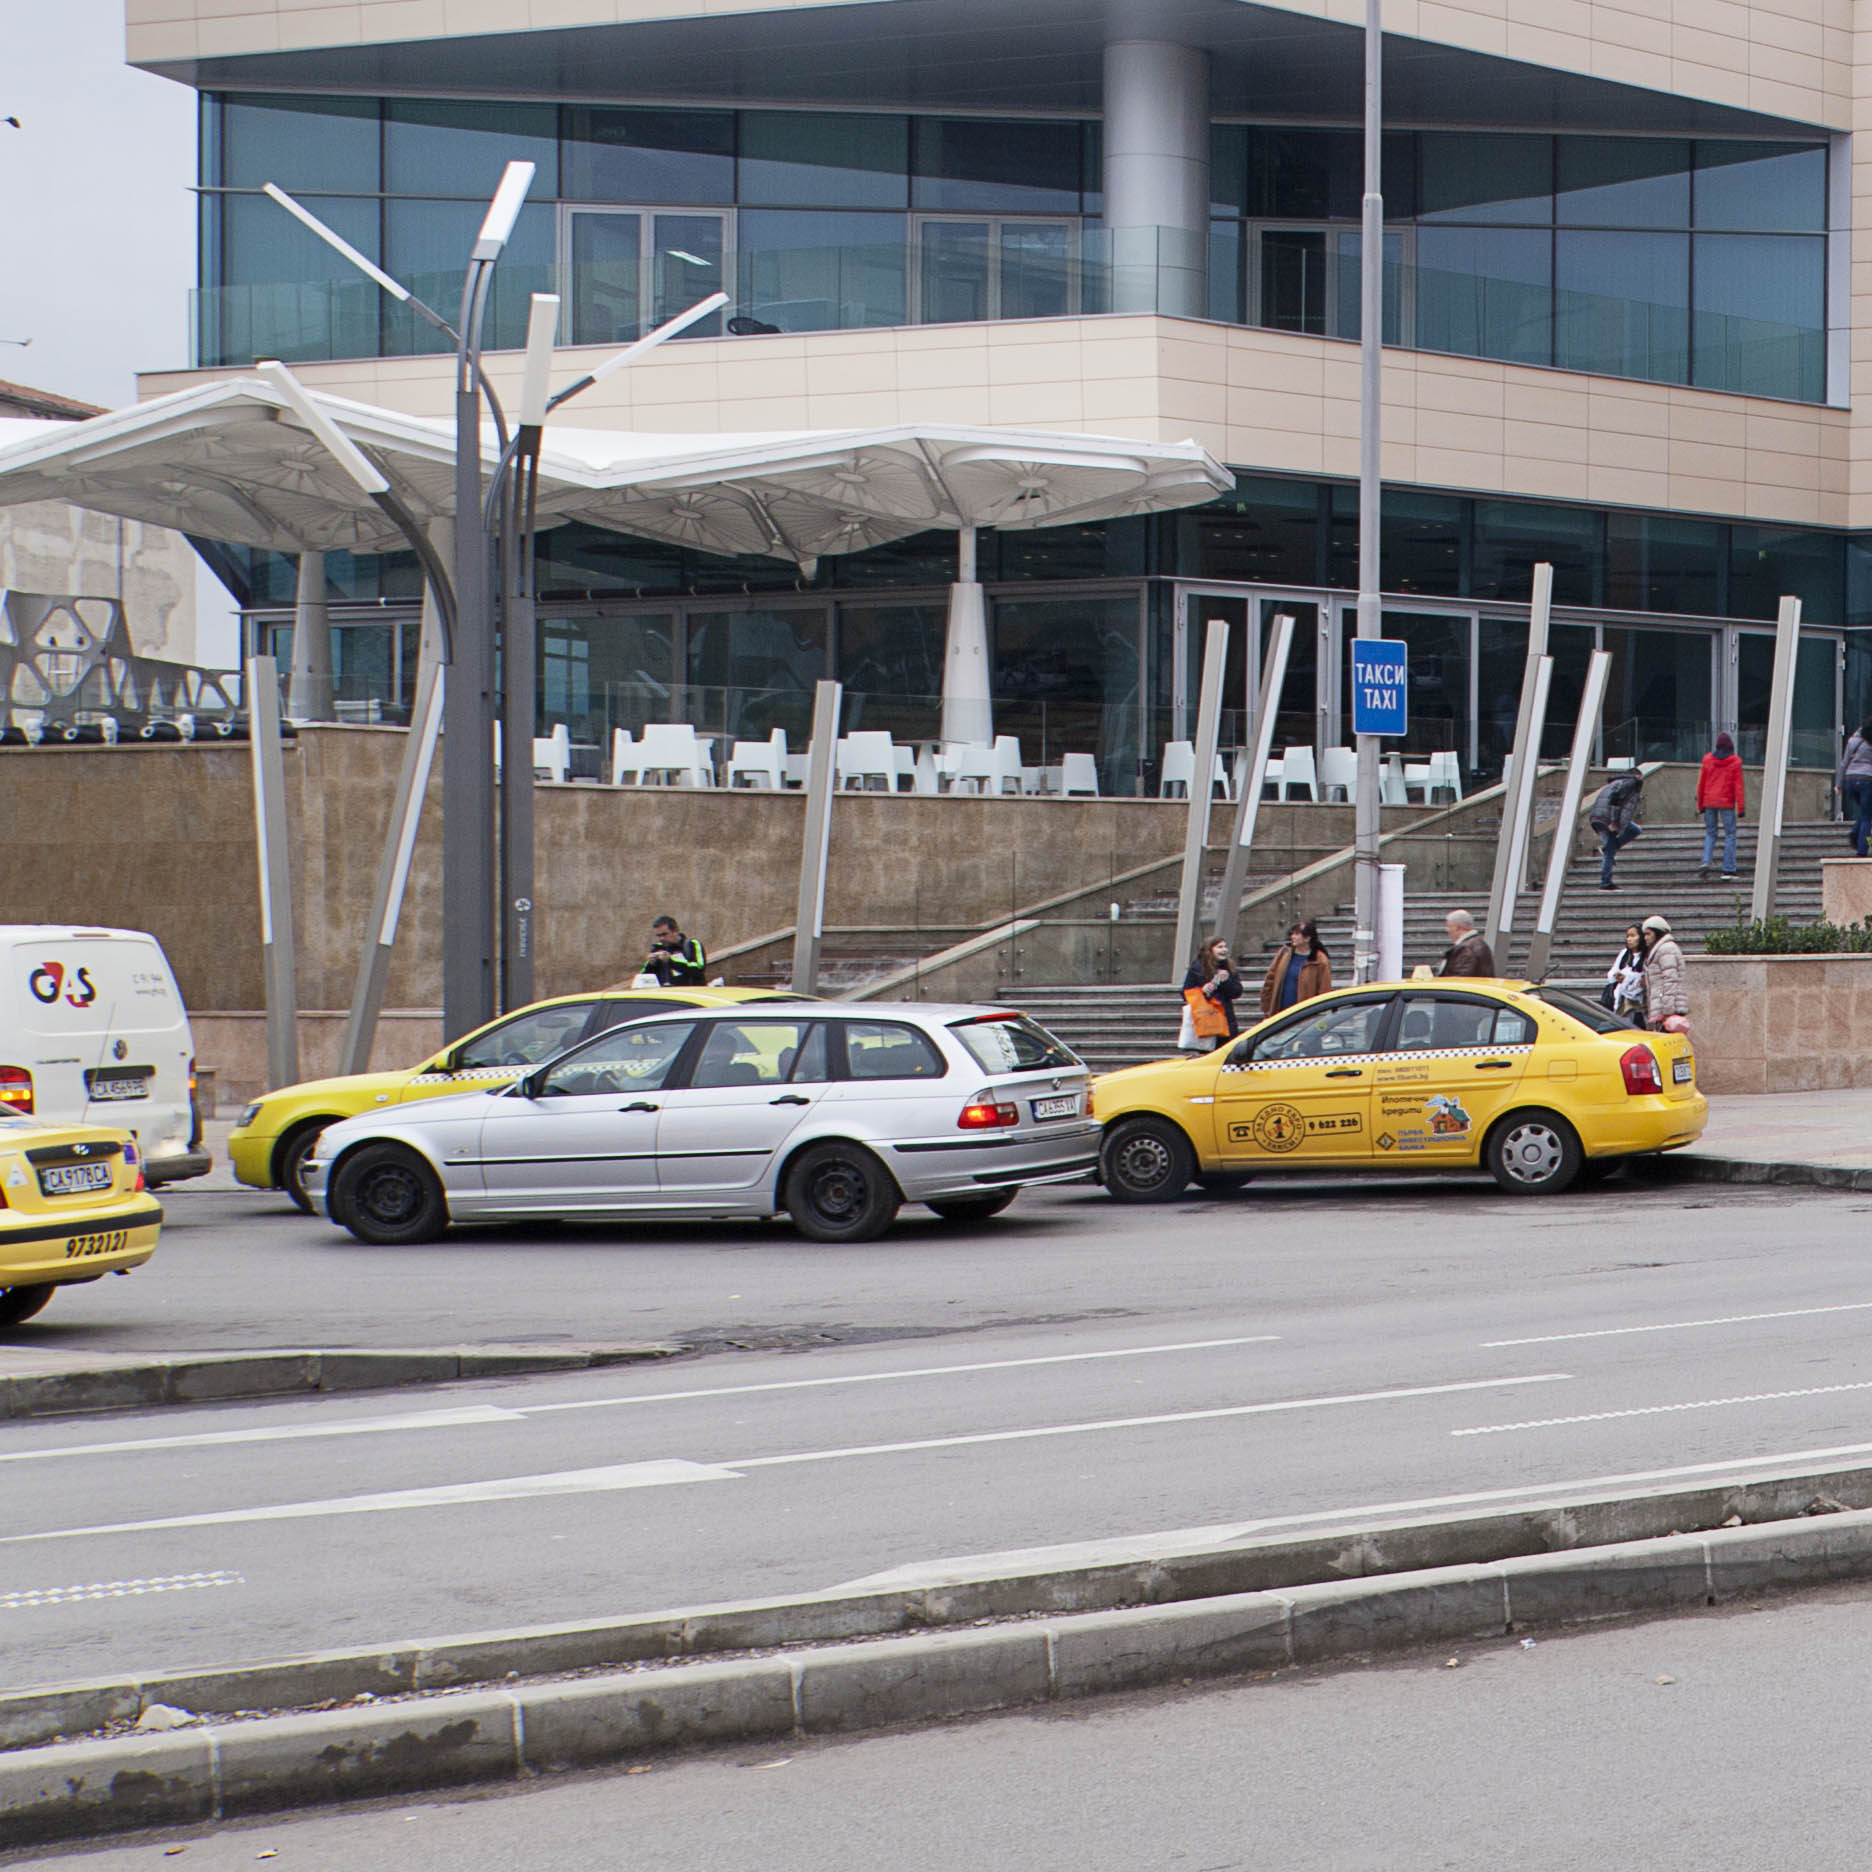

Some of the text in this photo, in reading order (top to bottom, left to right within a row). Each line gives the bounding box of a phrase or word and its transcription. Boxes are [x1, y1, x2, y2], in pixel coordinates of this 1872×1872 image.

[1355, 663, 1404, 685] ТАКСИ
[1363, 688, 1397, 710] TAXI
[65, 1230, 129, 1259] 9732121
